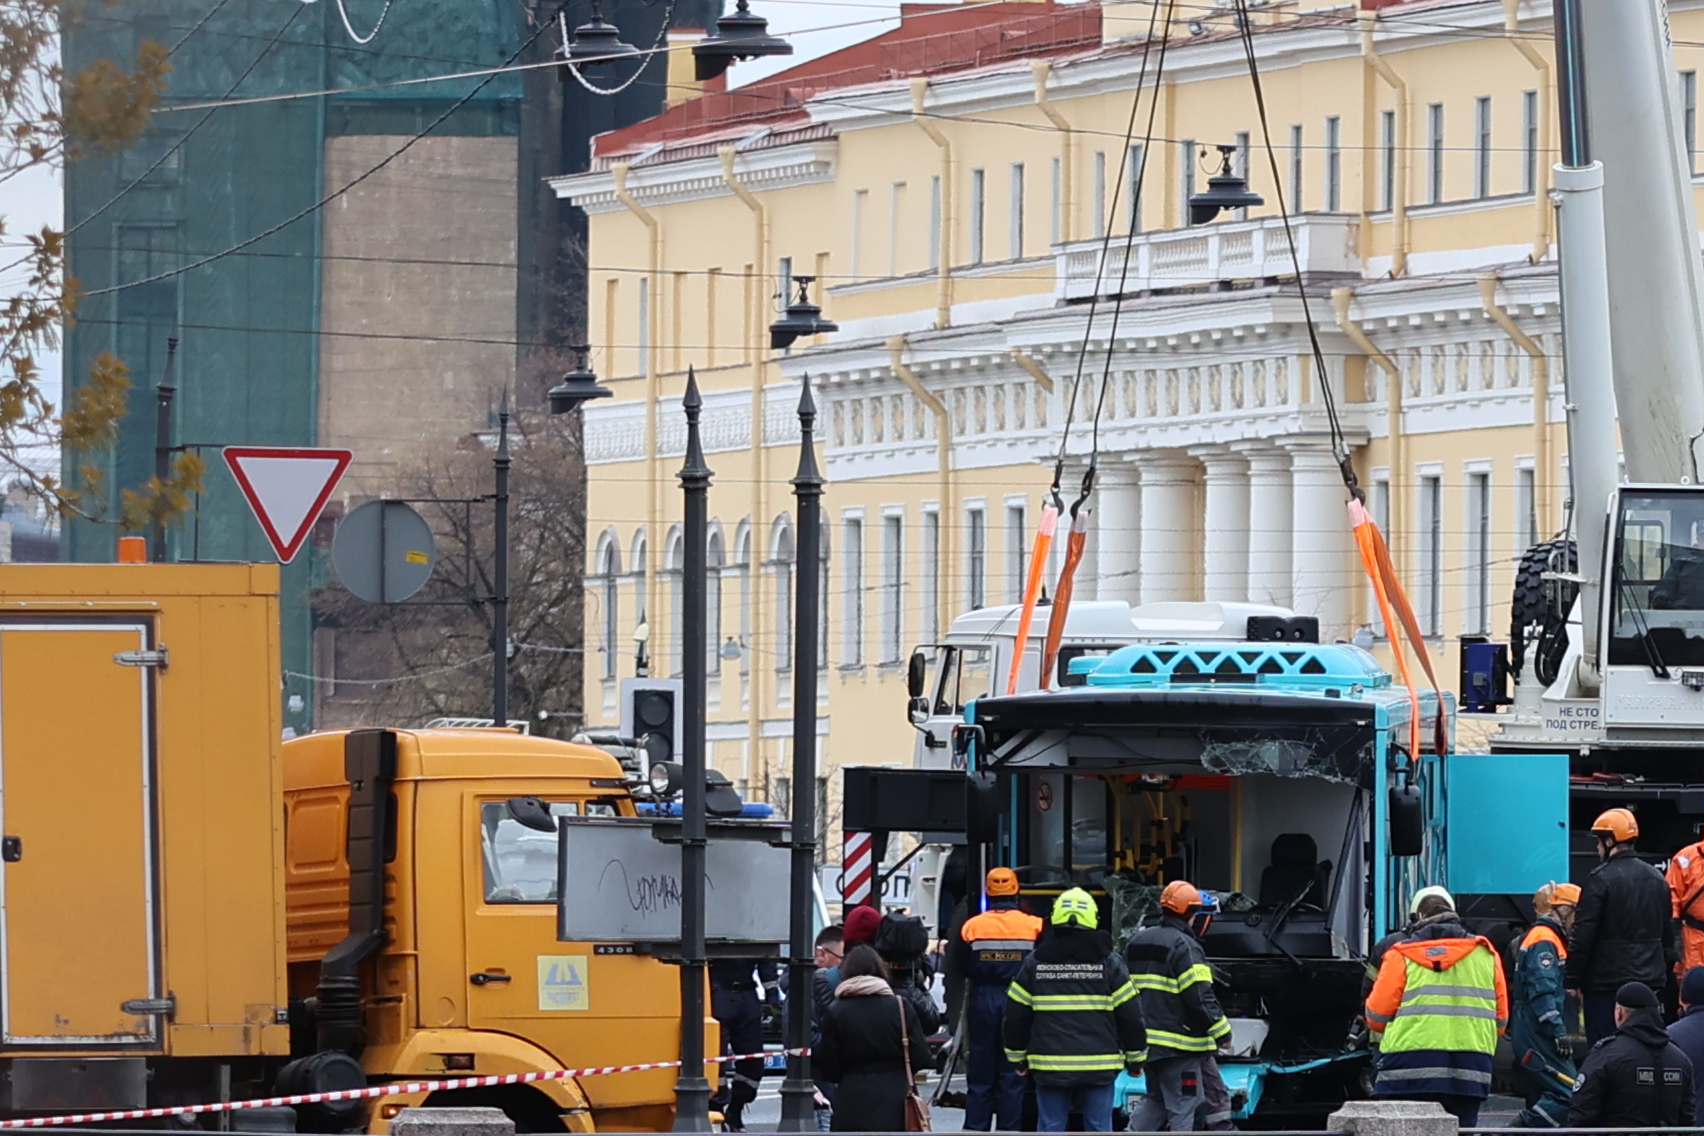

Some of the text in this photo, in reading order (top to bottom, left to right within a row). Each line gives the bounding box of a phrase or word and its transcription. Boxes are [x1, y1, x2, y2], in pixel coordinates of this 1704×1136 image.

[1559, 707, 1599, 717] НЕ СТО
[1546, 719, 1605, 730] ПОД СТРЕ
[1663, 1071, 1681, 1082] ССИИ
